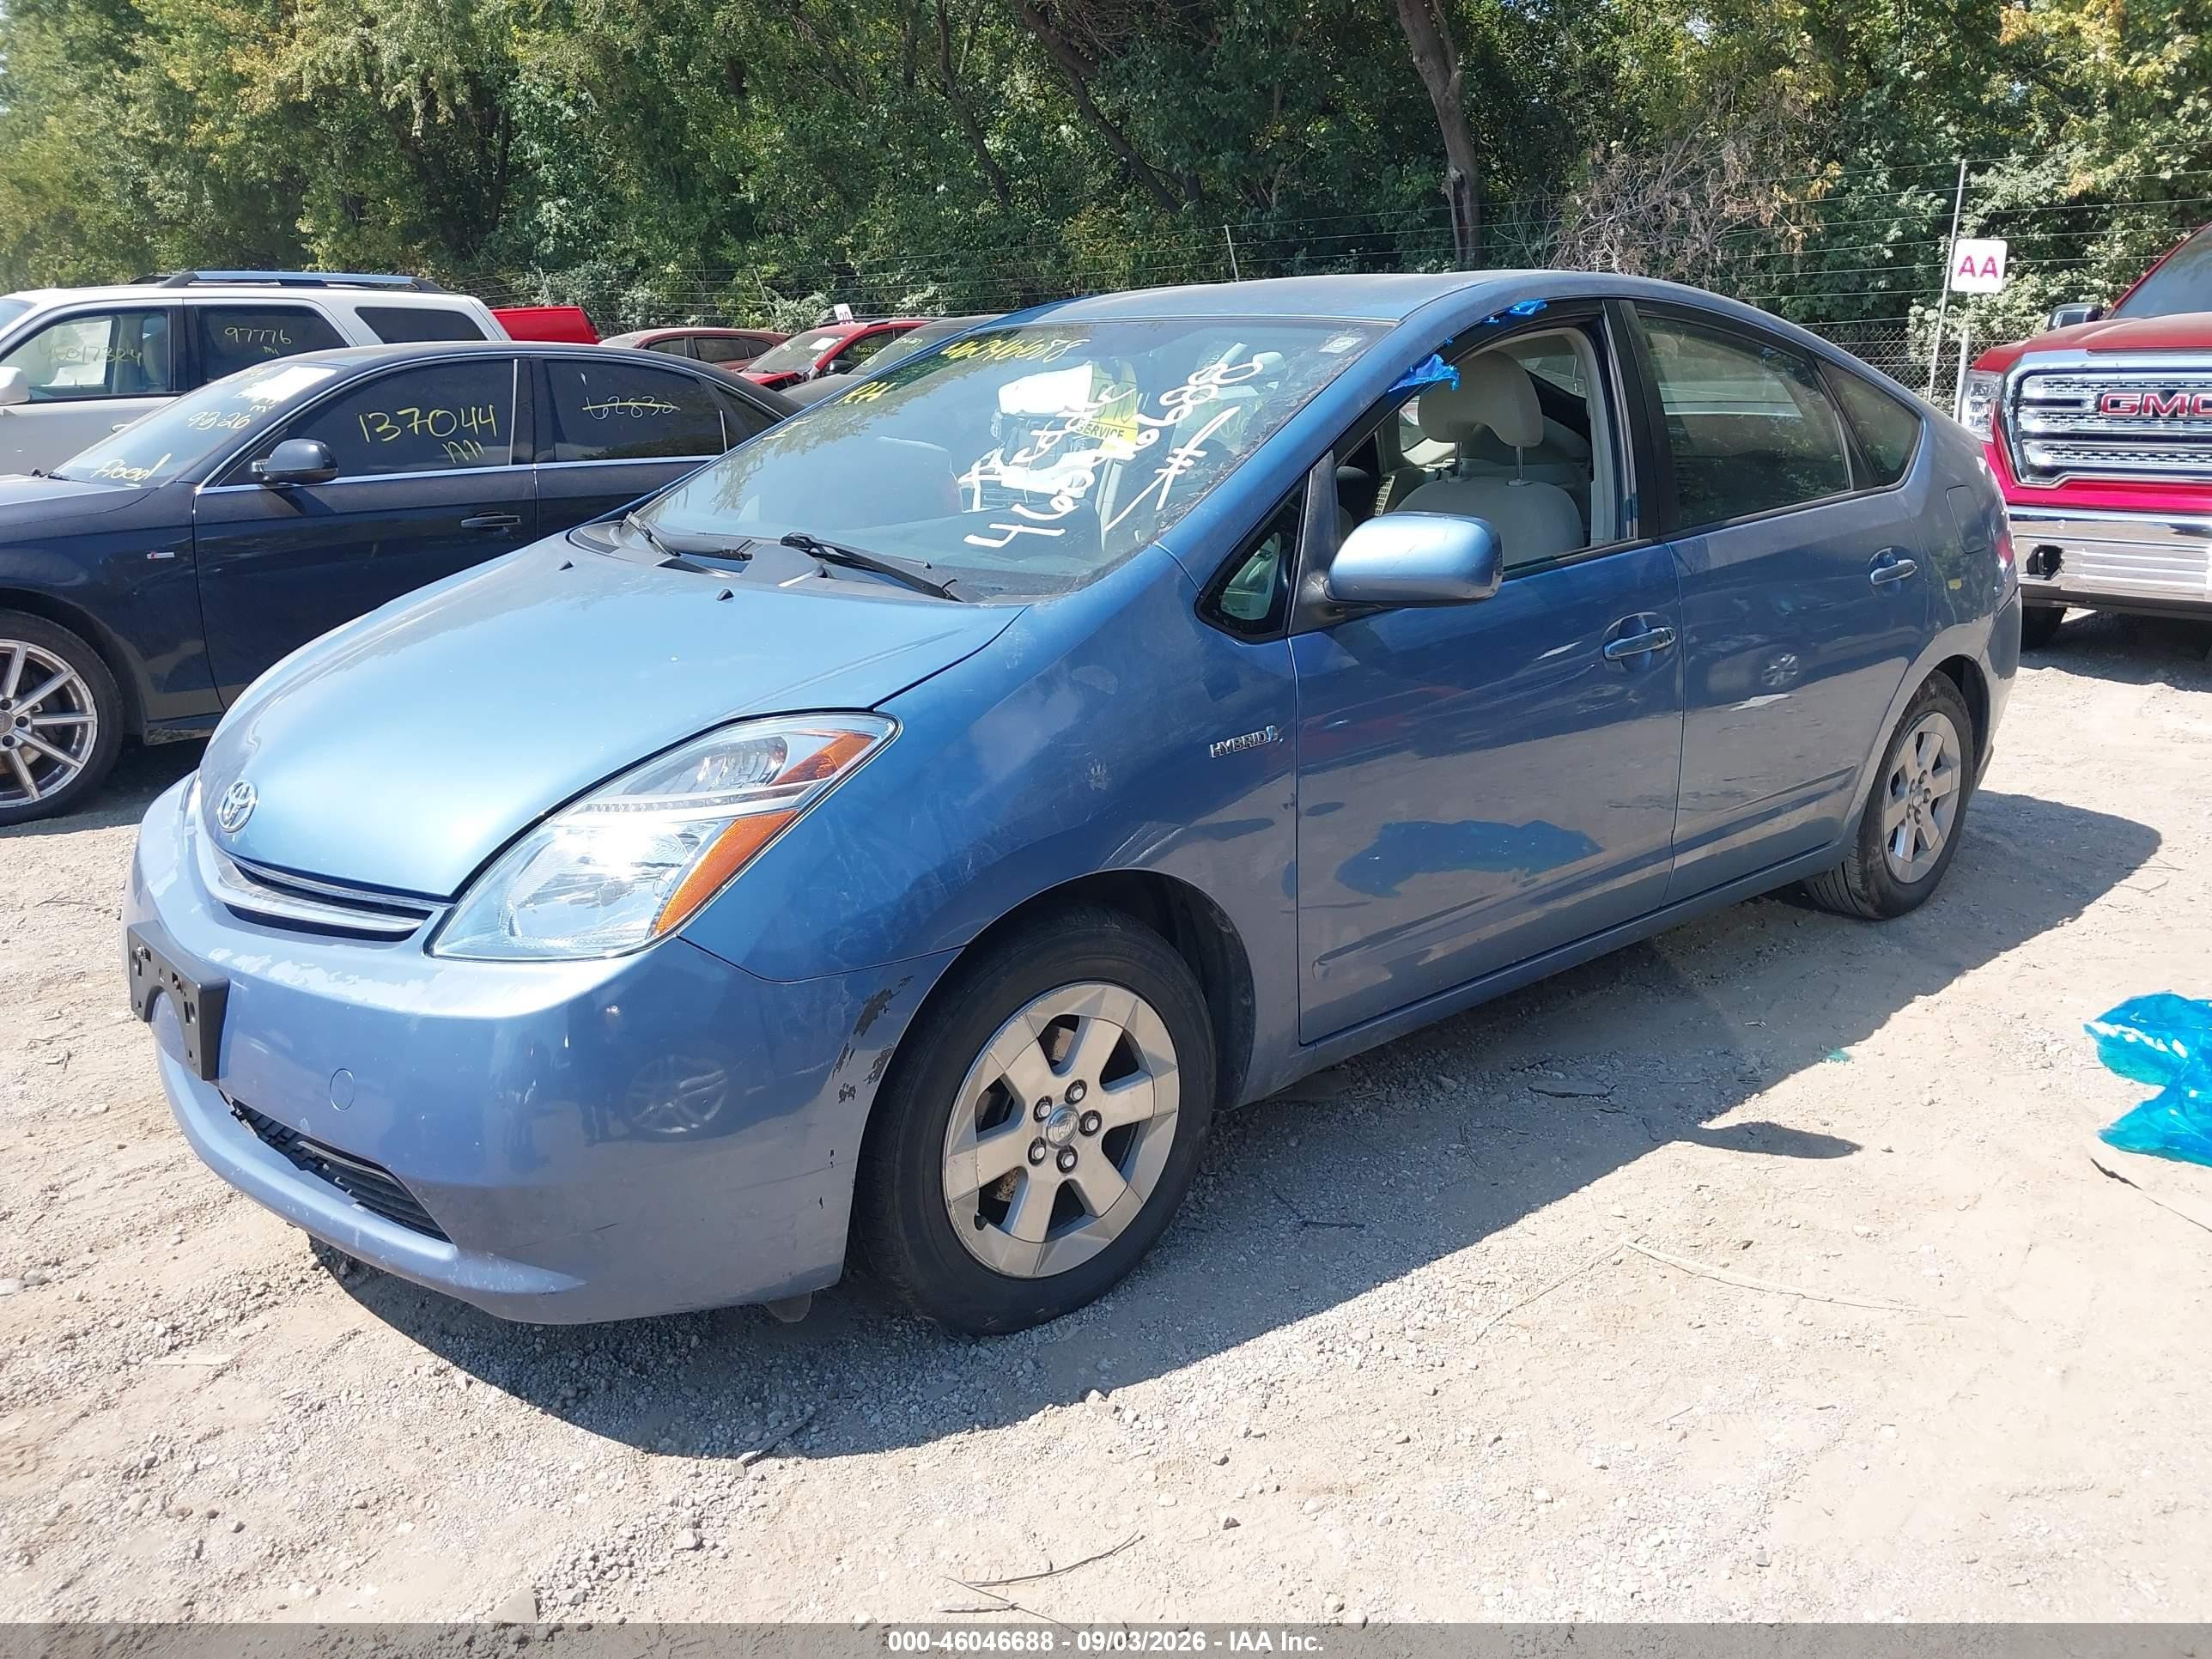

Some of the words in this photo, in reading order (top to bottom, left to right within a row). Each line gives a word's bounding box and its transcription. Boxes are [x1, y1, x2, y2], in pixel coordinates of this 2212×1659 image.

[1958, 255, 1998, 279] AA
[224, 327, 292, 344] 97776
[357, 404, 498, 443] 137044
[1209, 730, 1268, 758] HYBRID
